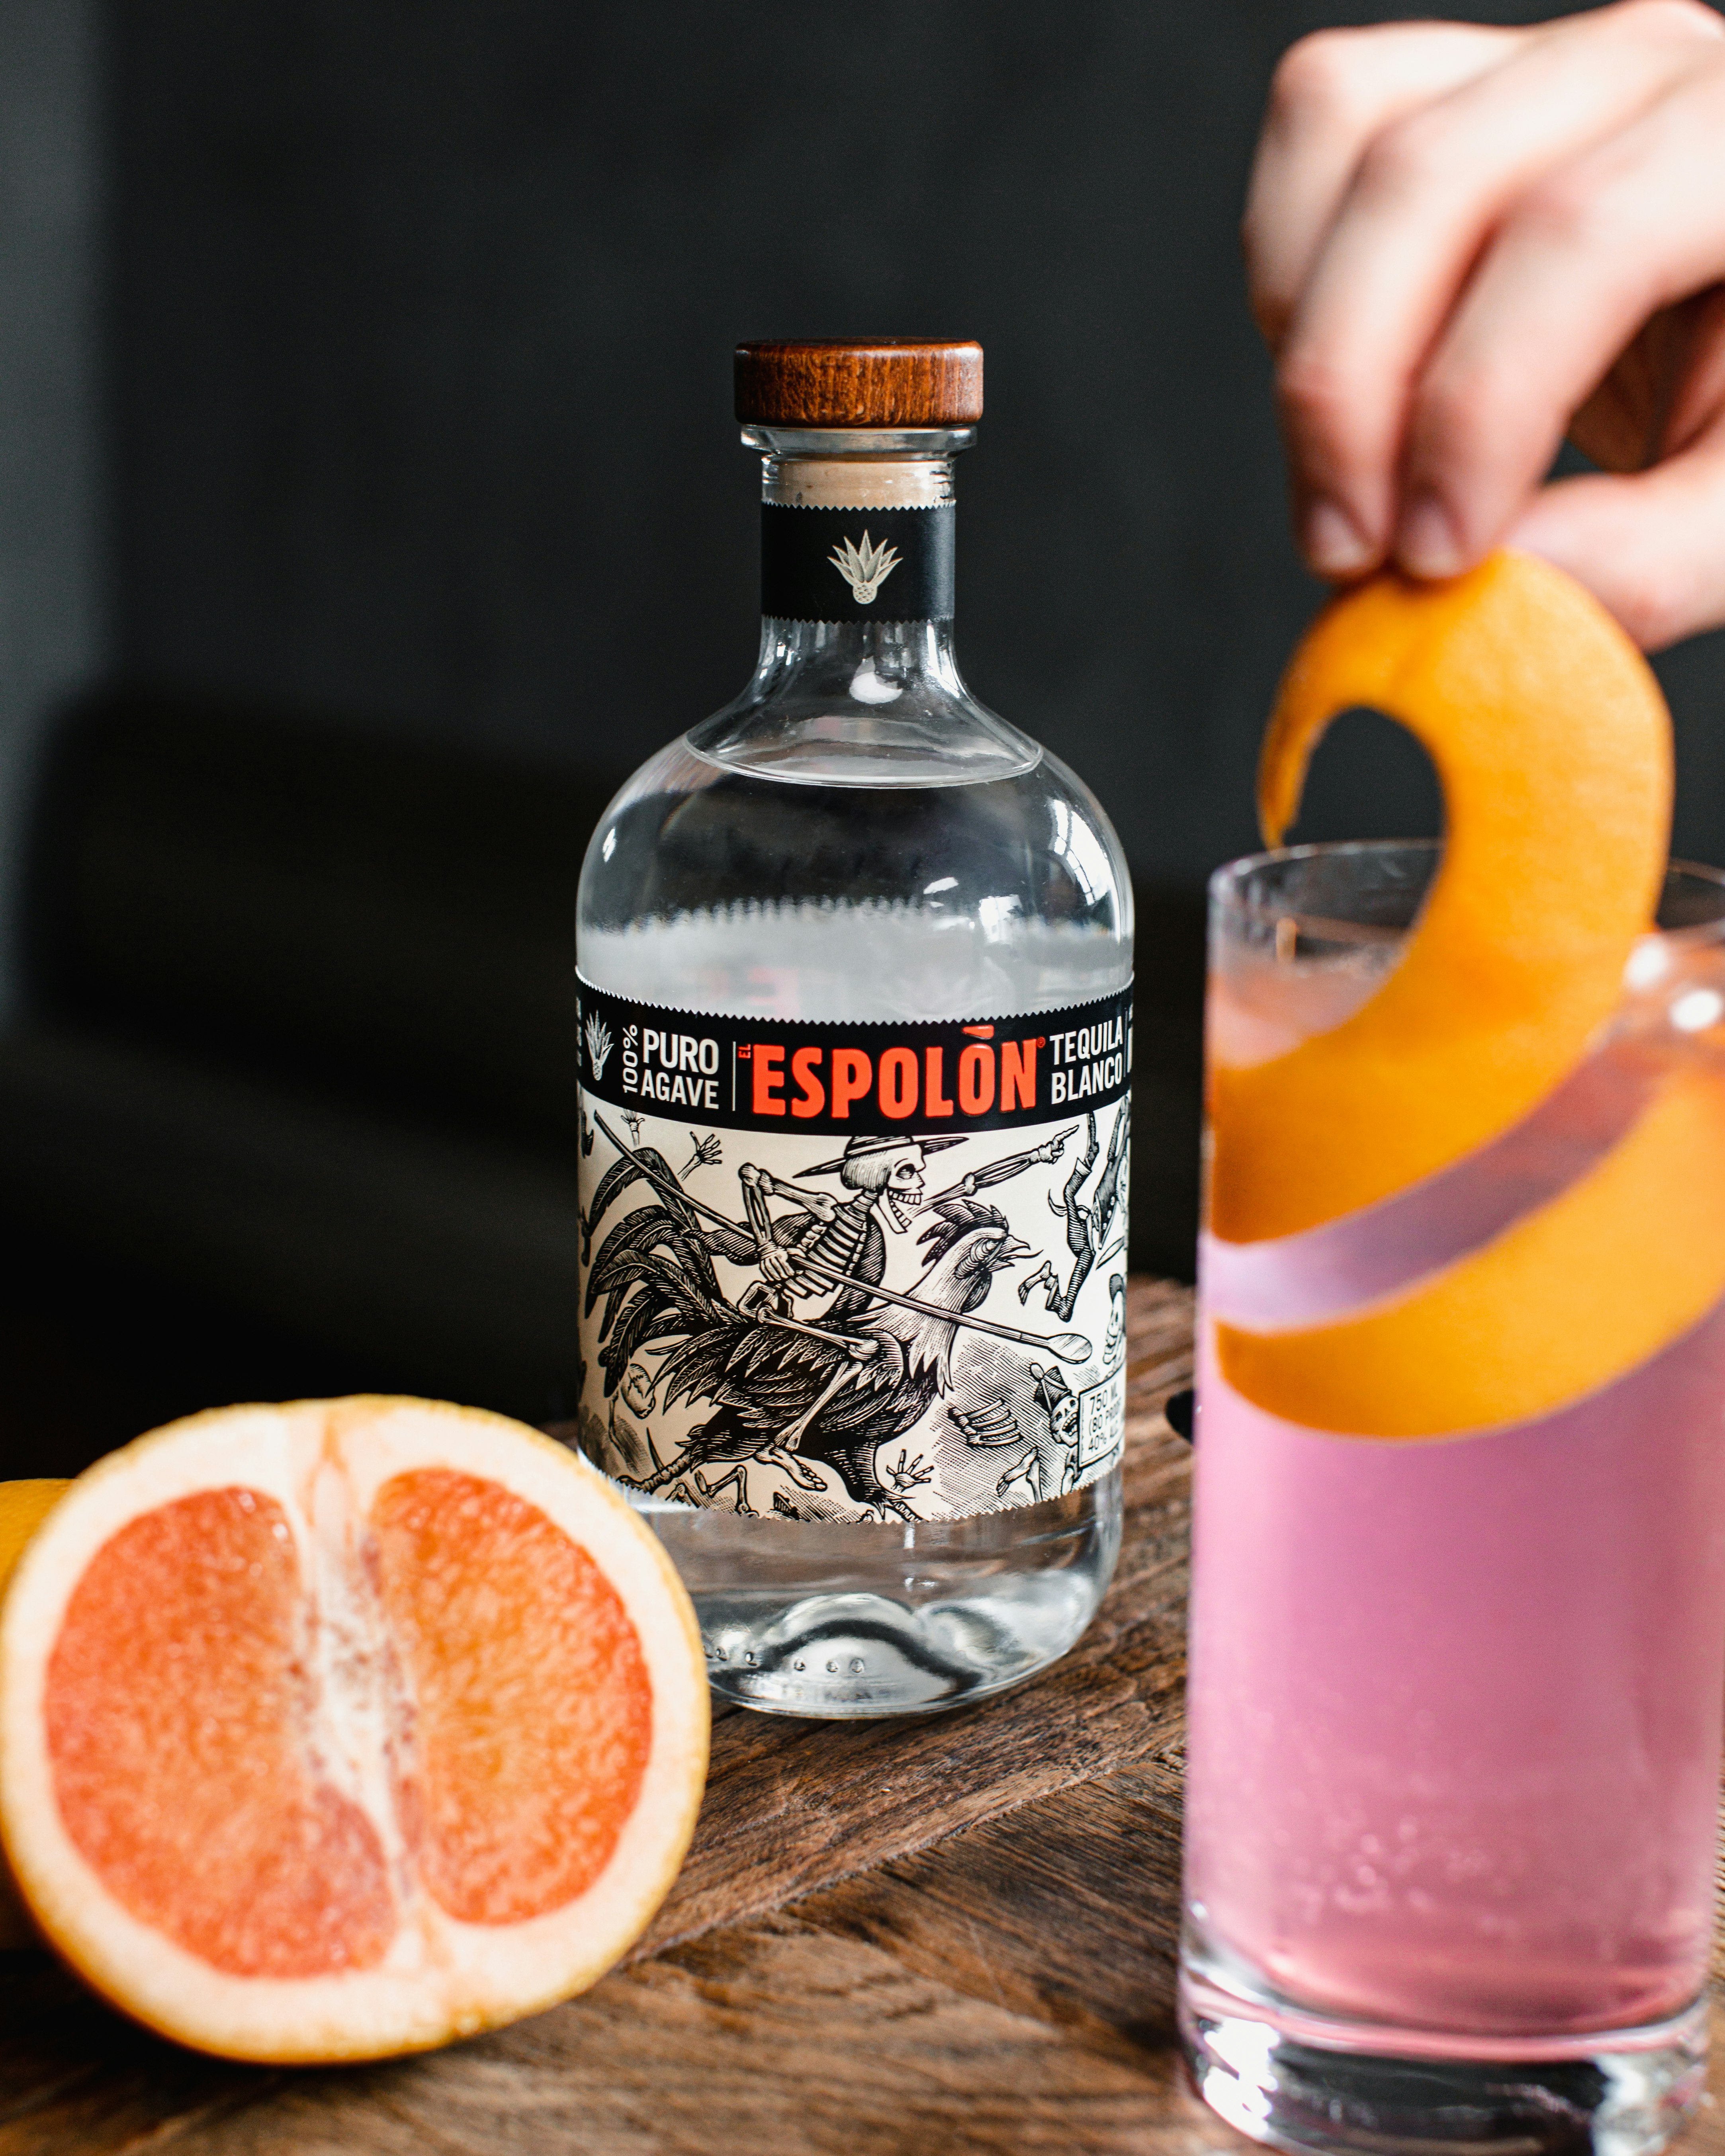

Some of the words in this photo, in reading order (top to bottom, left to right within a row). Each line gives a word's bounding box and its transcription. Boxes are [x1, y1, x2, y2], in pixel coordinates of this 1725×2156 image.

[622, 1025, 638, 1093] 100%
[643, 1028, 719, 1075] PURO
[738, 1044, 751, 1059] EL
[1049, 1015, 1123, 1065] TEQUILA
[640, 1069, 719, 1109] AGAVE
[1051, 1052, 1123, 1105] BLANCO
[1089, 1389, 1108, 1415] 750
[1088, 1433, 1107, 1452] 40%
[1089, 1414, 1103, 1436] (80
